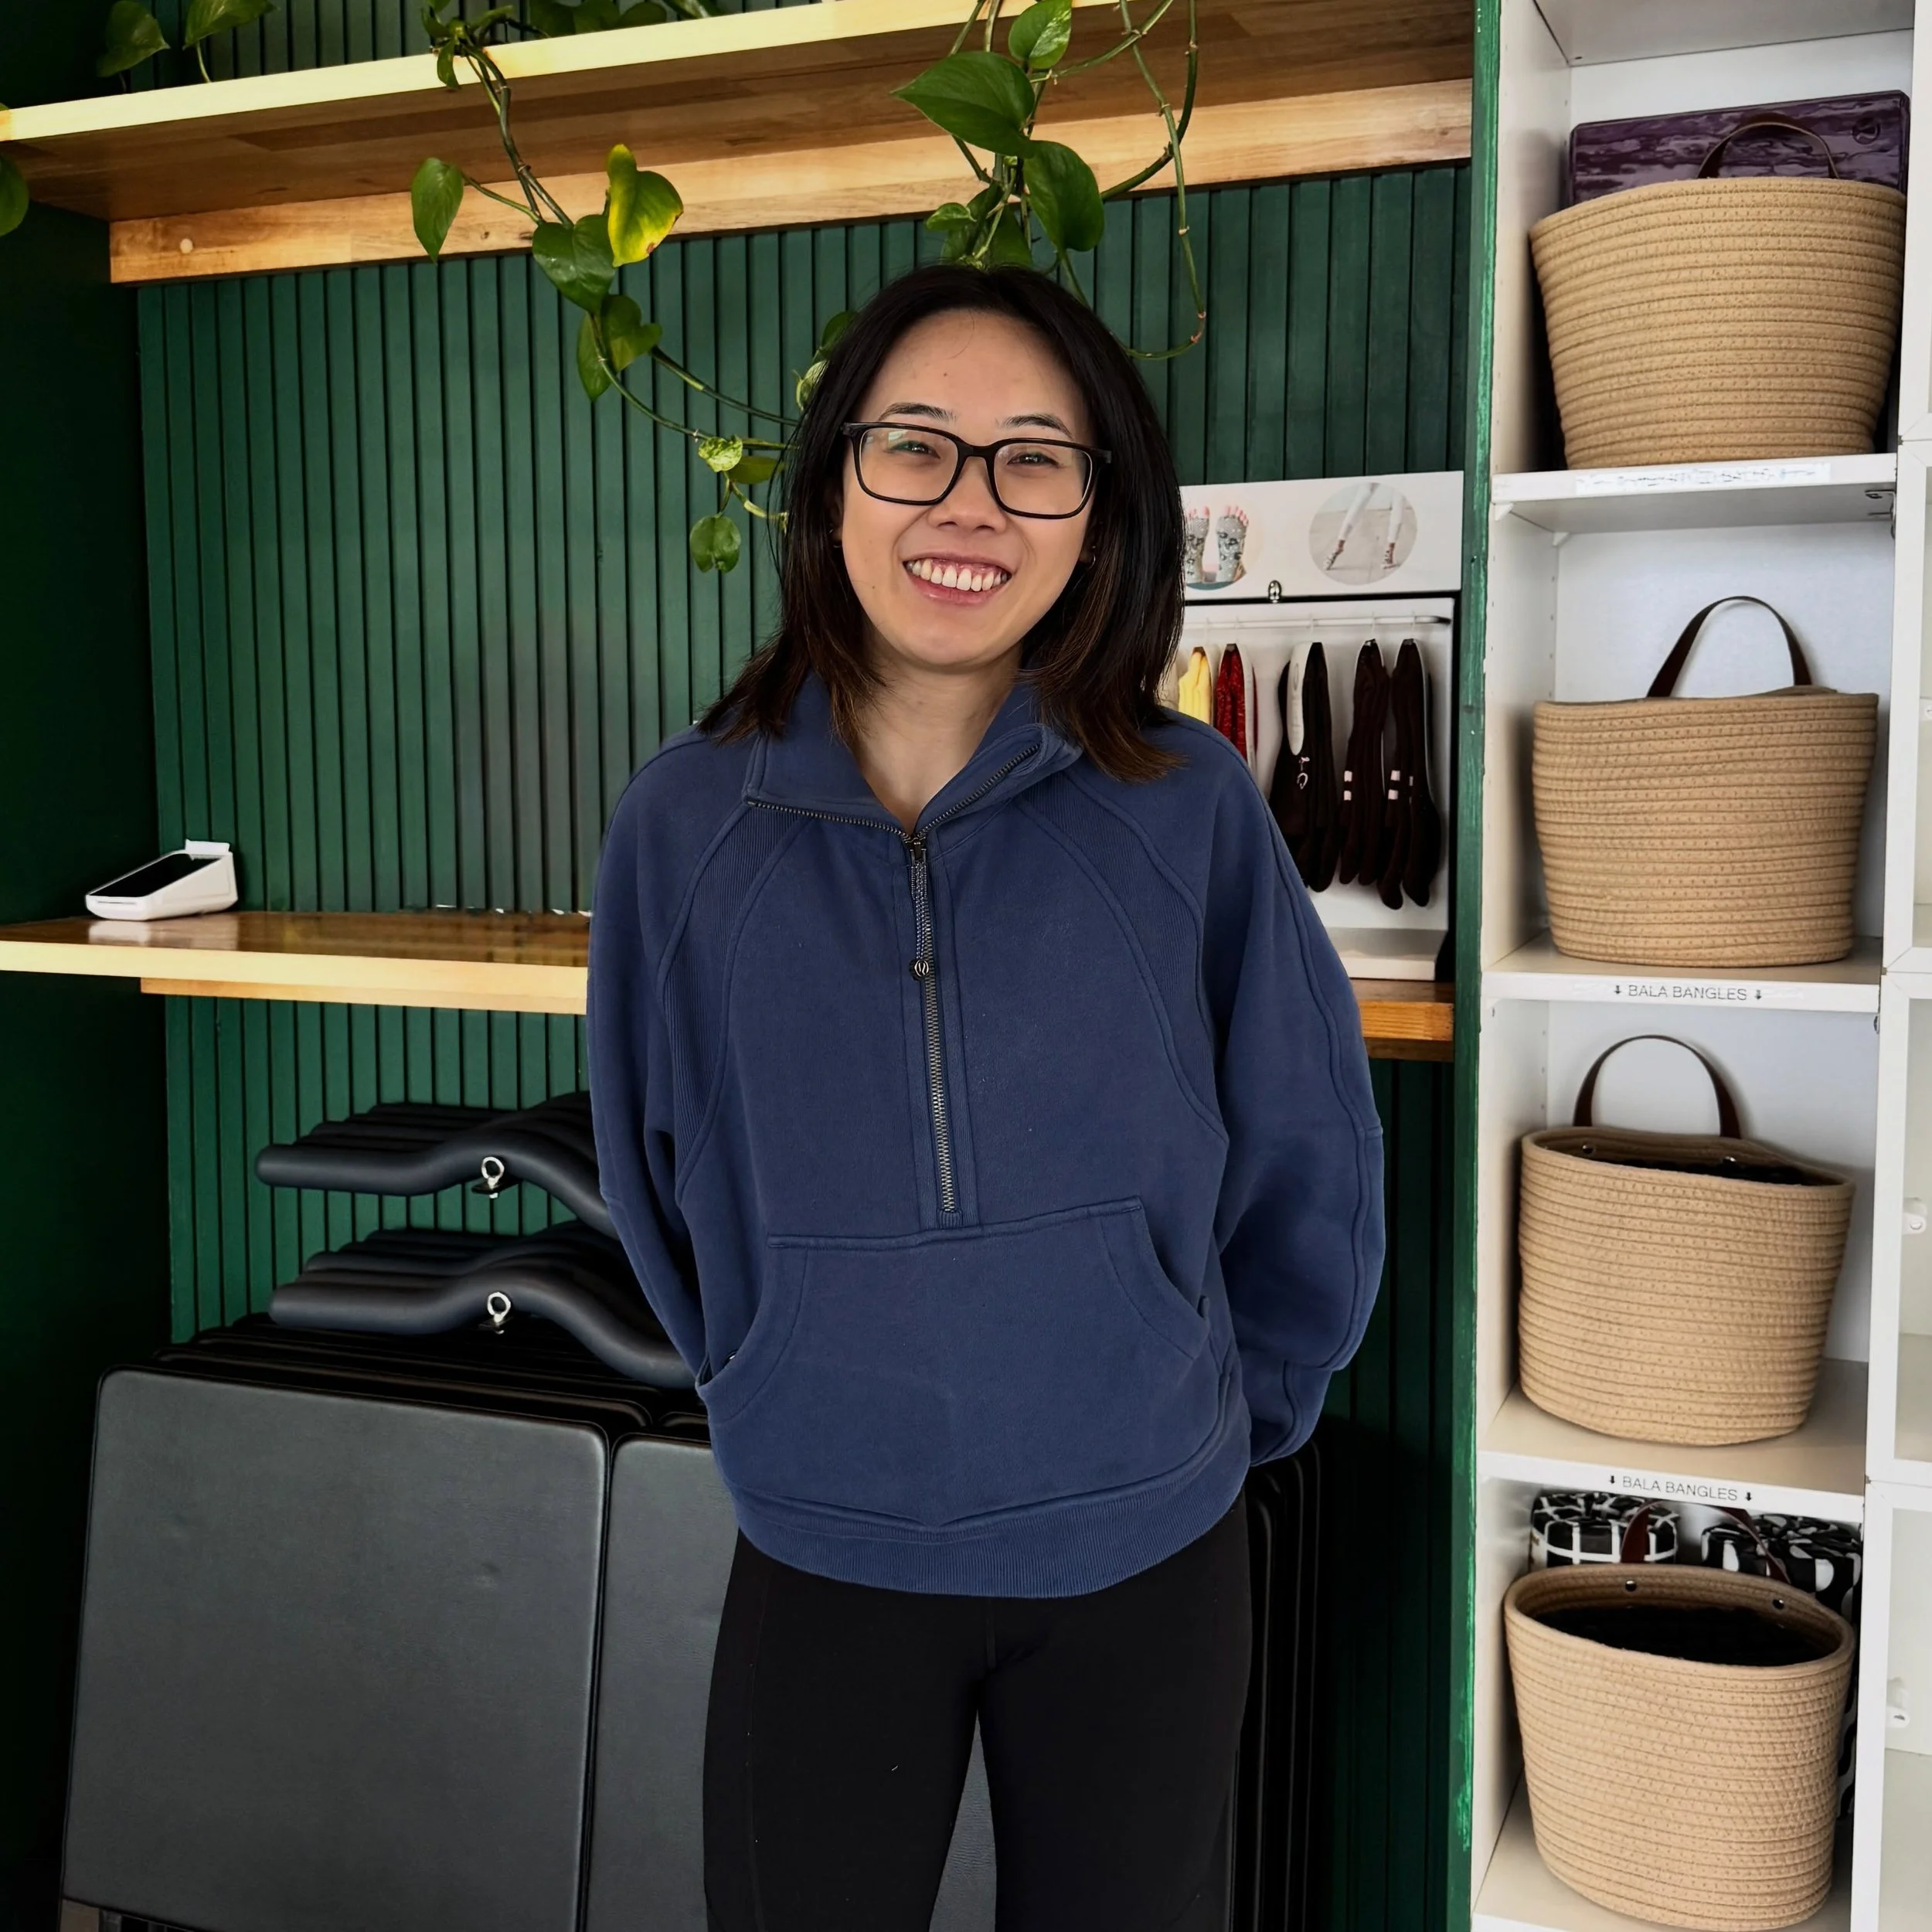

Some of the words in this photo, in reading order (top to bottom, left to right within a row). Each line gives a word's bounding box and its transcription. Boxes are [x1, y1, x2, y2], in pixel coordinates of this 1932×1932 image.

[1628, 985, 1668, 998] BALA
[1672, 986, 1747, 1001] BANGLES
[1623, 1476, 1661, 1492] BALA
[1665, 1481, 1738, 1501] BANGLES
